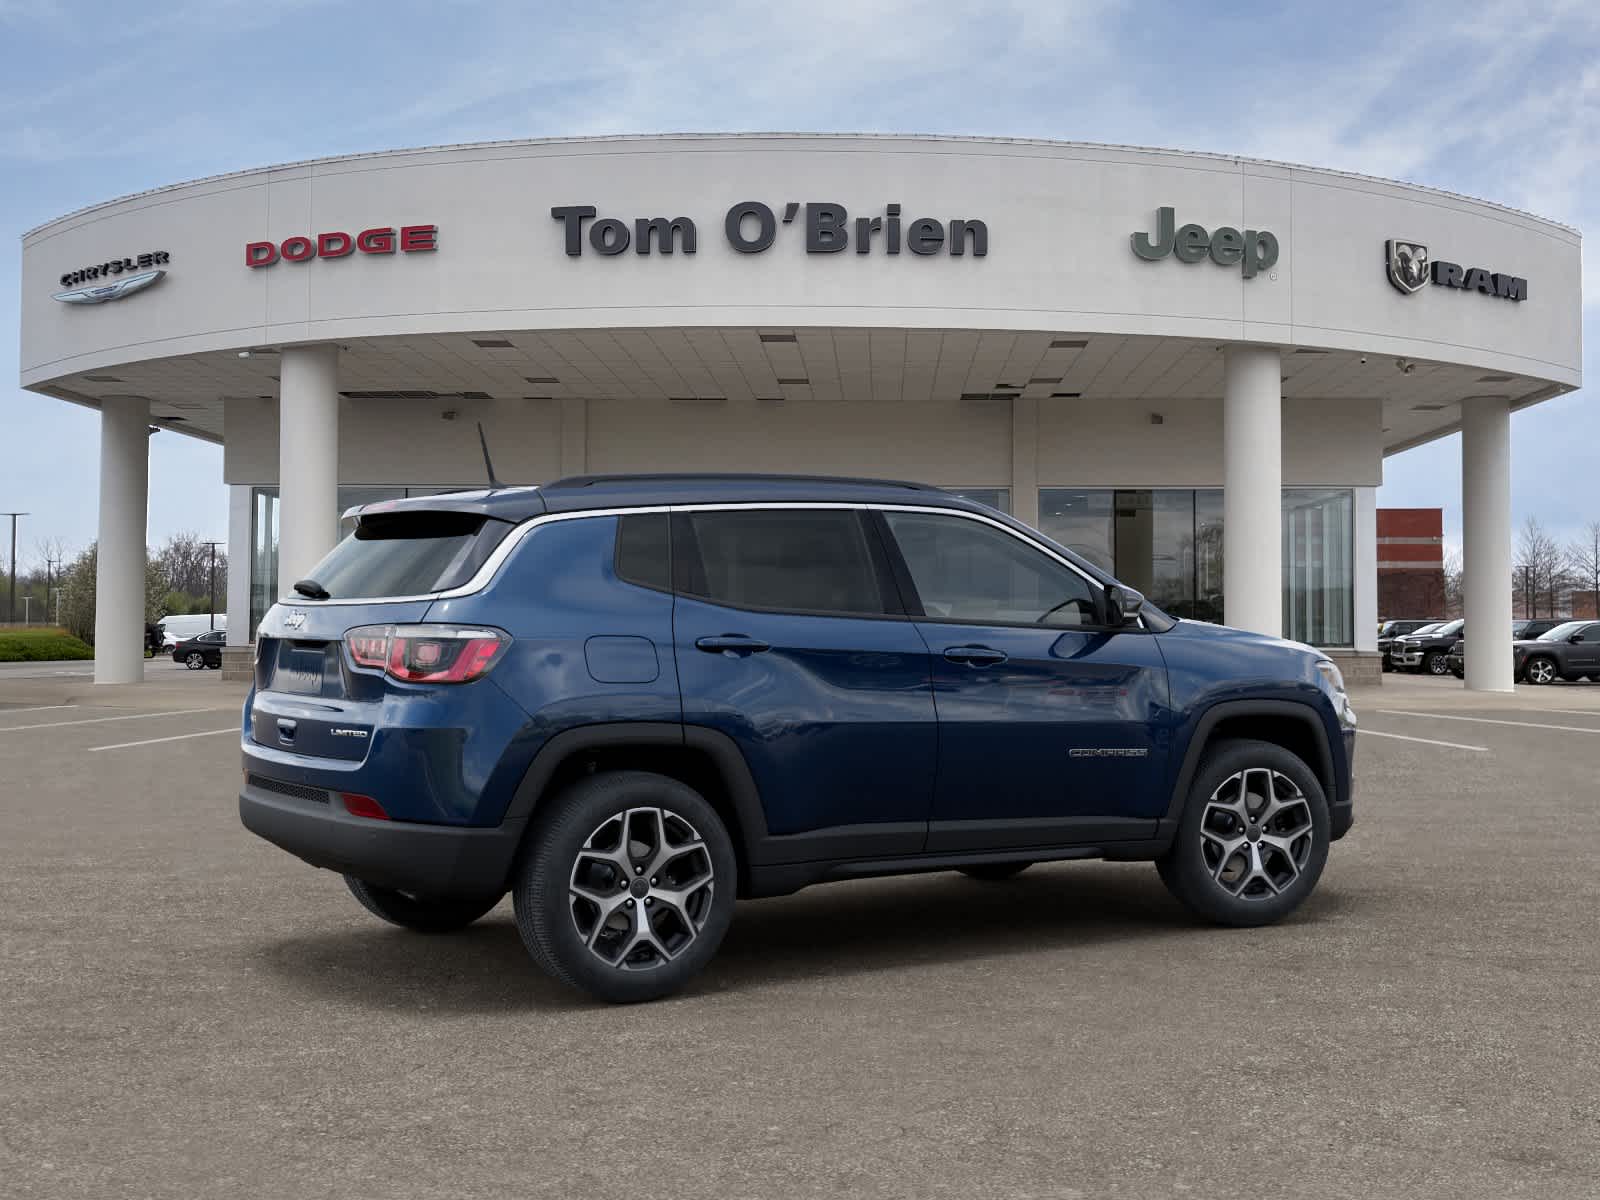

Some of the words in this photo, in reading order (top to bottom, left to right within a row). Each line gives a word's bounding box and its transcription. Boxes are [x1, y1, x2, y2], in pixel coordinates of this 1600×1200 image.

[246, 225, 438, 268] DODGE
[551, 205, 697, 256] Tom
[725, 201, 988, 256] O’Brien
[1131, 207, 1279, 279] Jeep
[60, 250, 170, 287] CHRYSLER
[1431, 261, 1528, 301] RAM
[330, 728, 368, 738] LIMITED
[1068, 748, 1148, 758] COMPASS
